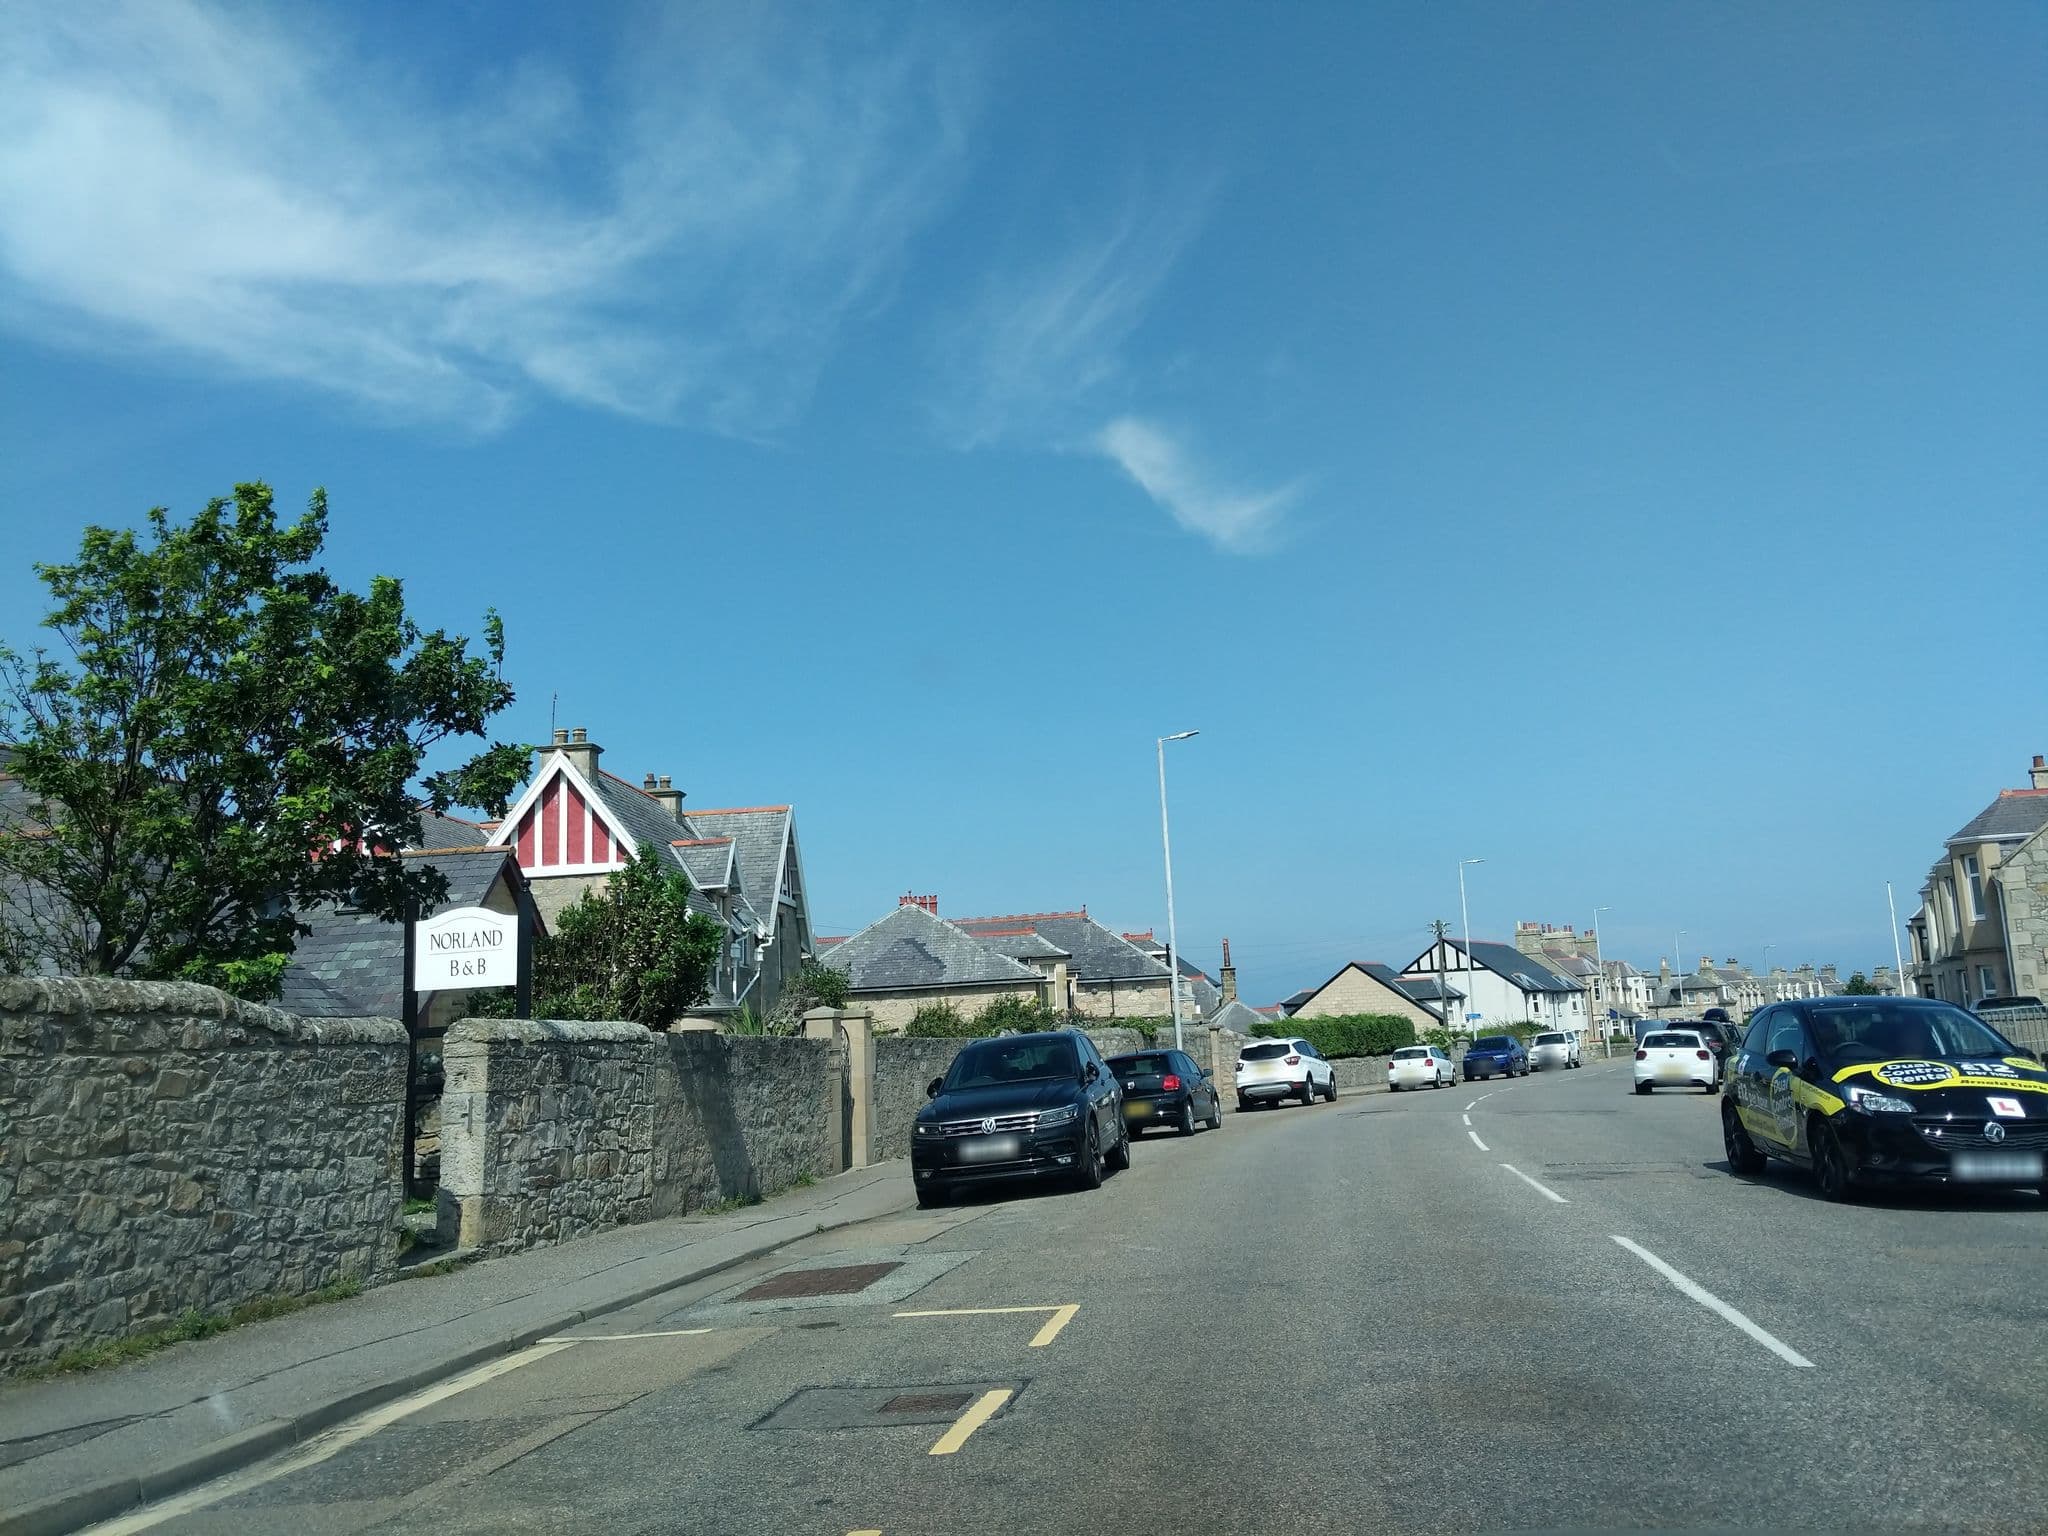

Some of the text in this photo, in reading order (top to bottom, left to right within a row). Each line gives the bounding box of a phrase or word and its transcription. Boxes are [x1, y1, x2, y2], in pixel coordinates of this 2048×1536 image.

[430, 930, 503, 951] NORLAND
[1878, 1066, 1951, 1077] Control
[1886, 1062, 1931, 1071] Dual
[1960, 1063, 2015, 1074] £12
[1889, 1072, 1954, 1085] Rental
[1997, 1101, 2016, 1112] L
